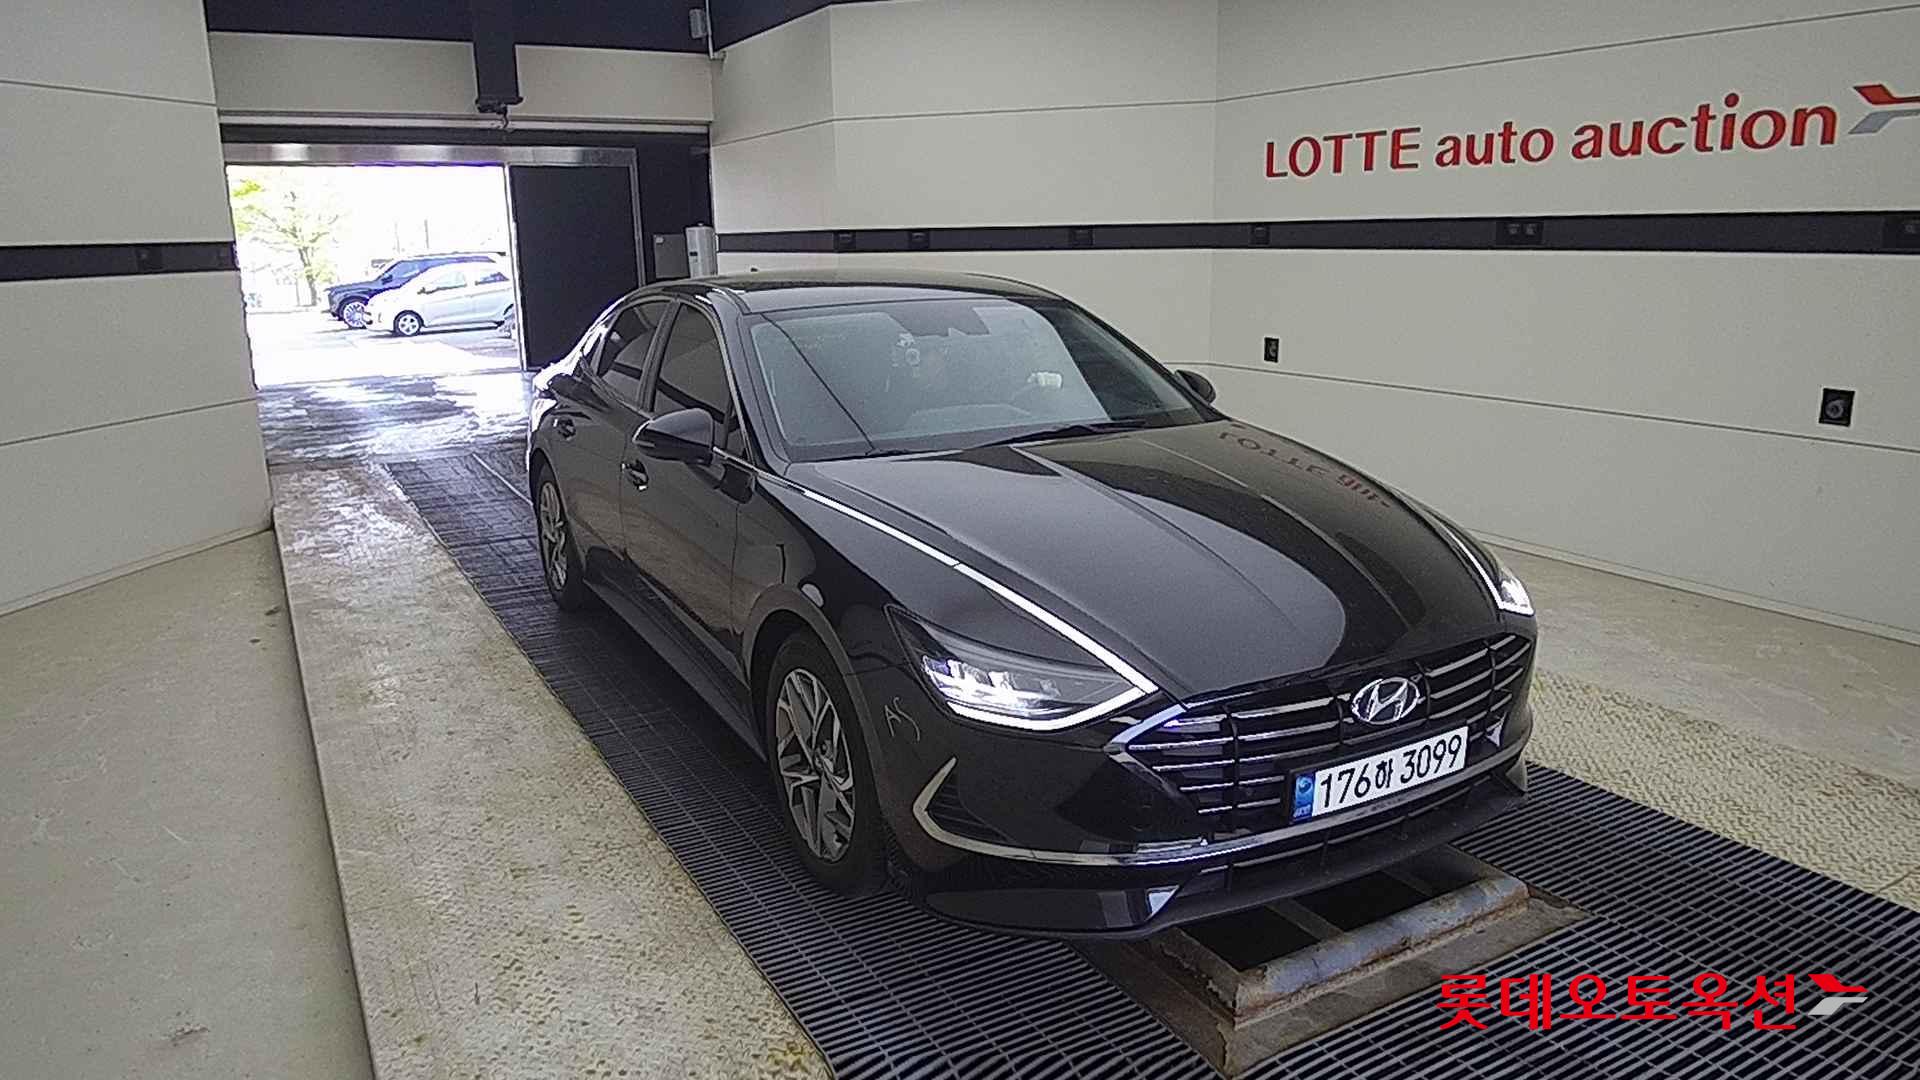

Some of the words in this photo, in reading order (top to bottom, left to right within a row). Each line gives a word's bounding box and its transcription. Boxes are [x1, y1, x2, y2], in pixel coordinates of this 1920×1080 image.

[1264, 127, 1422, 178] LOTTE
[1435, 122, 1557, 168] auto
[1571, 94, 1838, 161] auction
[1320, 757, 1394, 809] 176하
[1399, 734, 1463, 785] 3099
